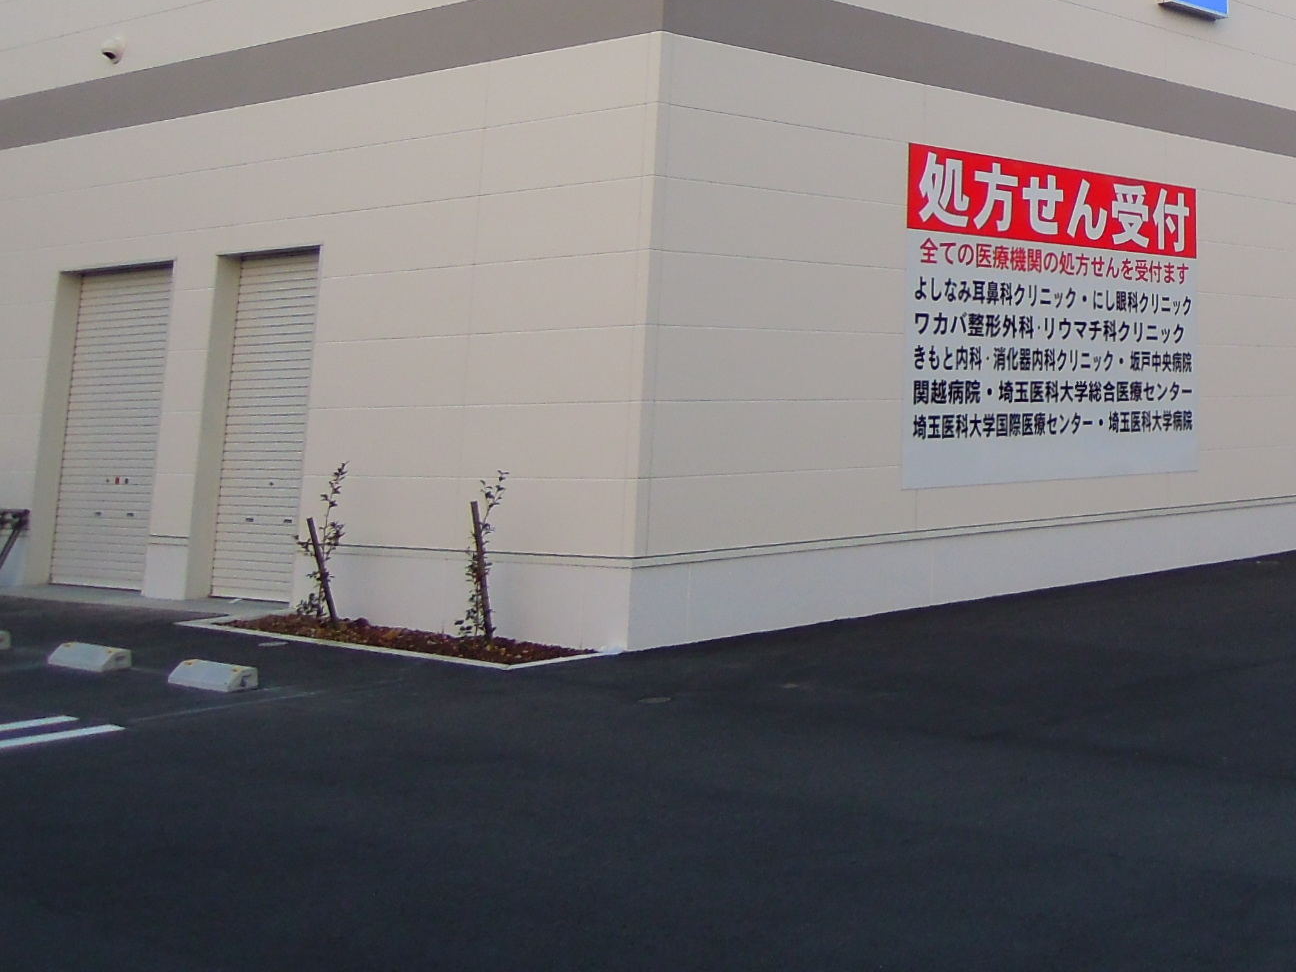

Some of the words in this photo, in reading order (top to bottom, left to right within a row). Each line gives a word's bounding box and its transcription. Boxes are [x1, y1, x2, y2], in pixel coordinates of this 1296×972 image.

[919, 151, 1190, 253] 処方せん受付
[920, 237, 1189, 285] 全ての医療機関の処方せんを受付ます
